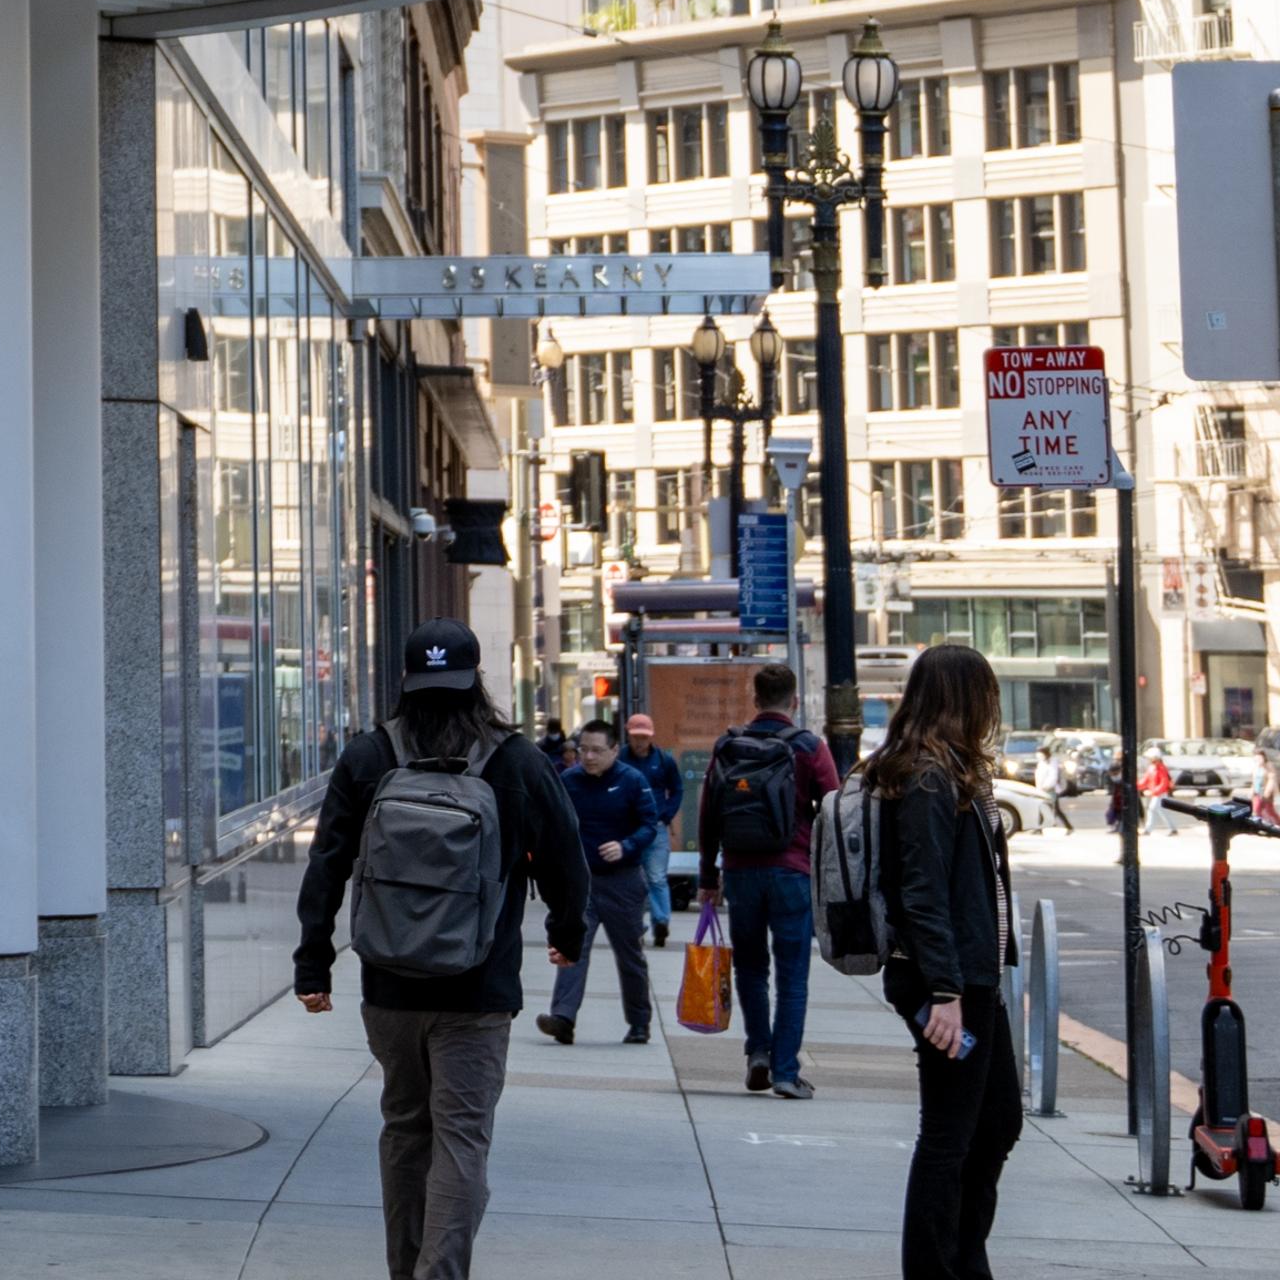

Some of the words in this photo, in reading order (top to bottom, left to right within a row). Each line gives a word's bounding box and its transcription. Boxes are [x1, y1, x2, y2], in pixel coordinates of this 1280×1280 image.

[503, 262, 675, 290] KEARNY
[1001, 351, 1087, 369] TOW-AWAY
[988, 370, 1022, 397] NO
[1026, 376, 1102, 396] STOPPING
[1022, 409, 1073, 430] ANY
[1018, 435, 1079, 456] TIME
